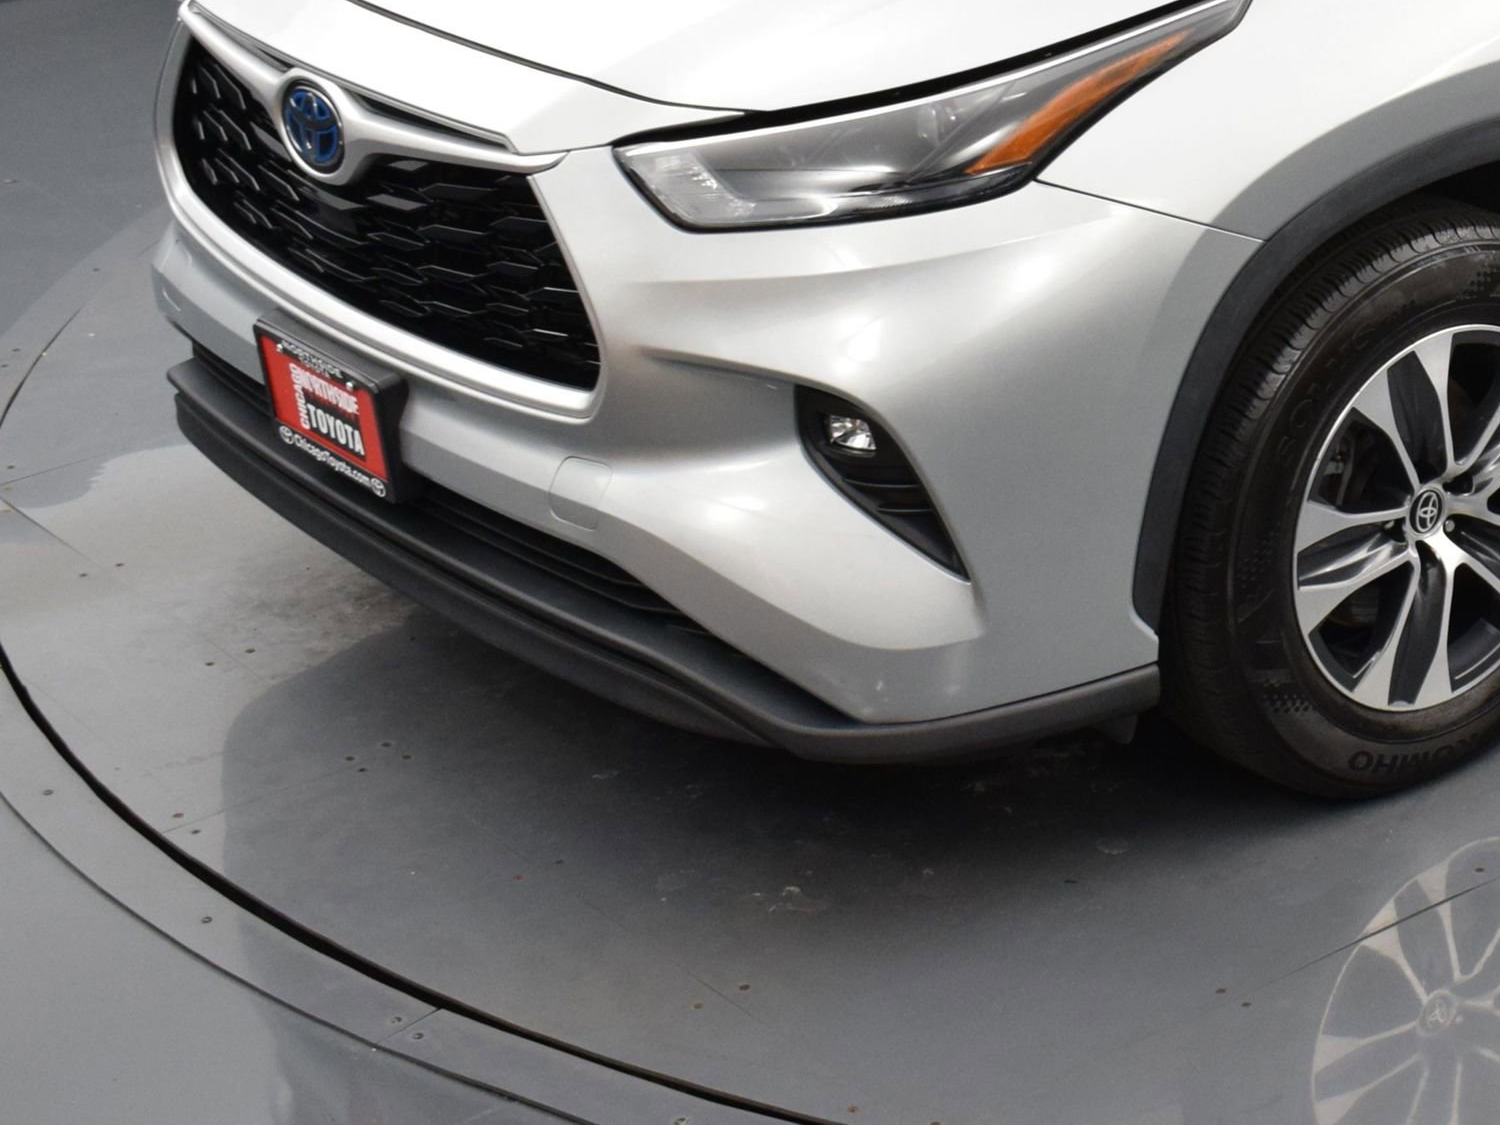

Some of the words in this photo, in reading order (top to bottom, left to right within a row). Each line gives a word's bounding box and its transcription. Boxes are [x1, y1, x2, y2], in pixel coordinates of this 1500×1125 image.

[288, 362, 311, 431] CHICAGO
[300, 369, 360, 416] NORTHSIDE
[306, 402, 365, 456] TOYOTA
[1348, 733, 1478, 774] KUMHO
